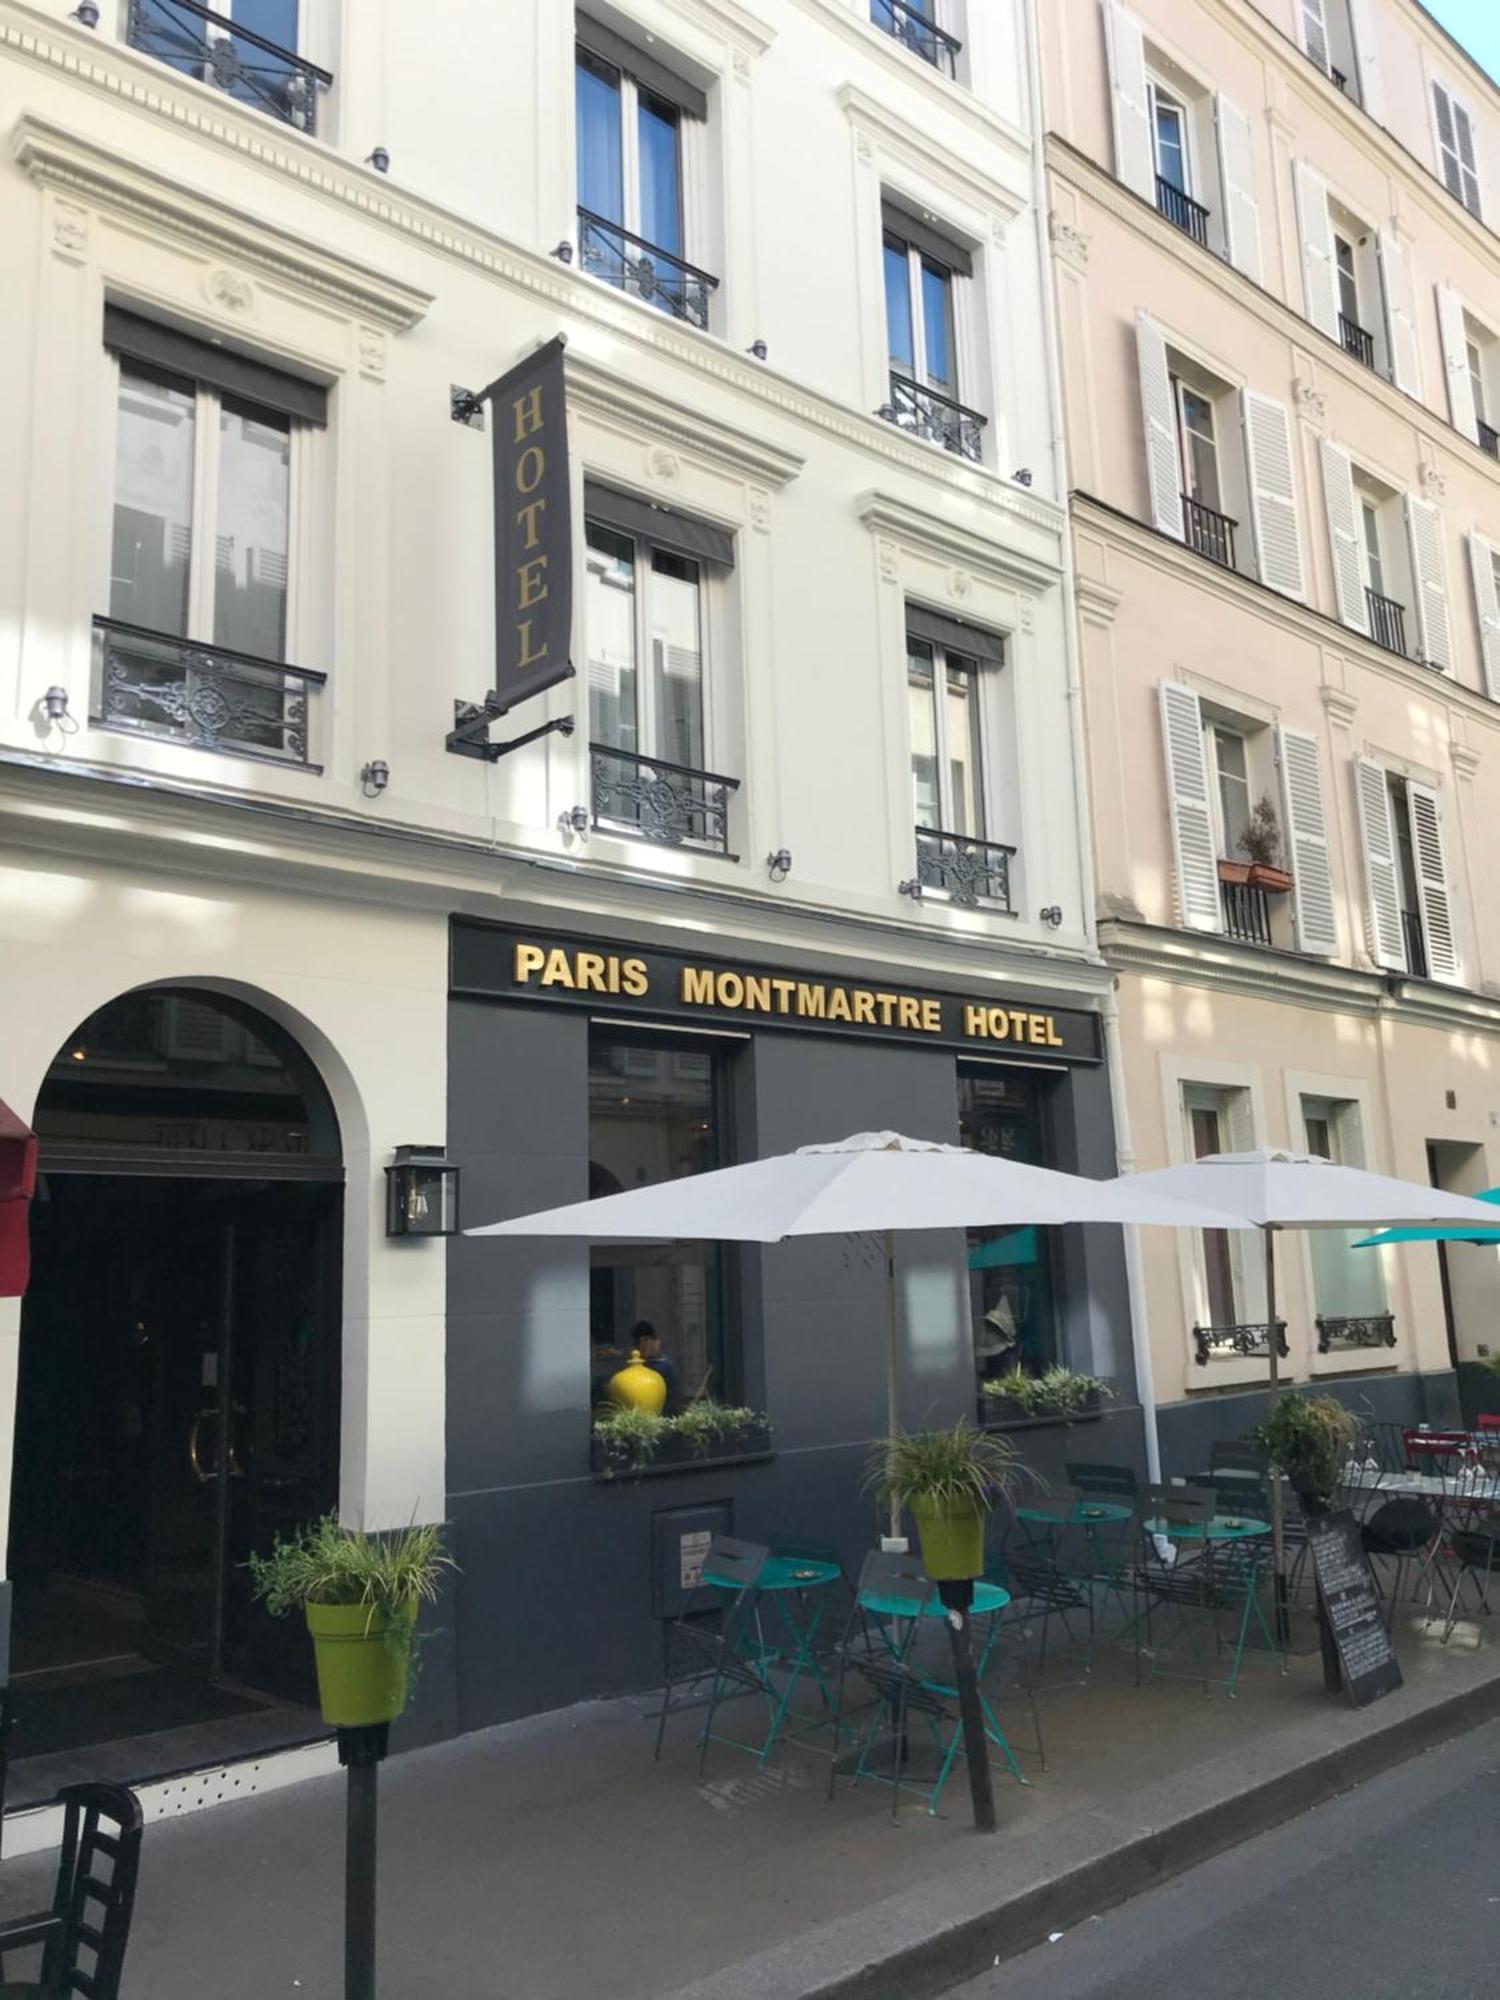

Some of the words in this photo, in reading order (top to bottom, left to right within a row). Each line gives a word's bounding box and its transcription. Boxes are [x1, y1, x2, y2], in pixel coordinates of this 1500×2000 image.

[512, 384, 549, 667] HOTEL
[514, 944, 649, 996] PARIS
[683, 967, 942, 1032] MONTMARTRE
[964, 1005, 1063, 1046] HOTEL
